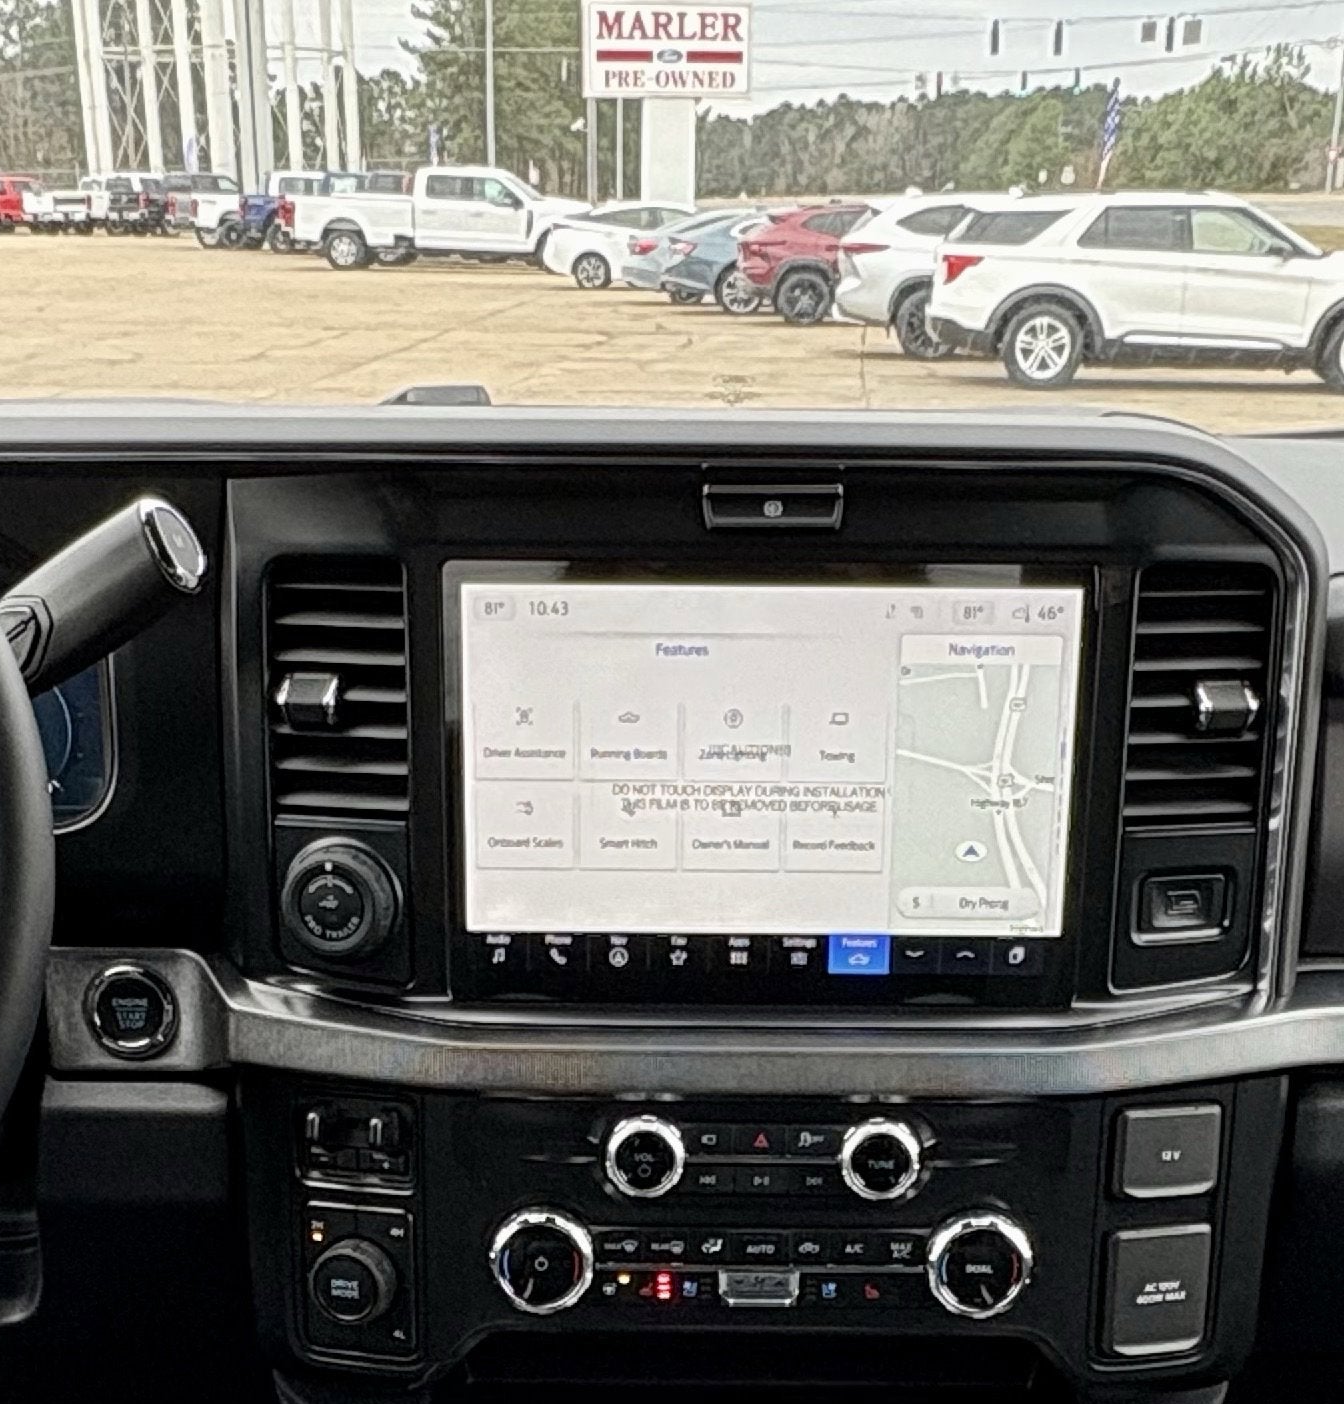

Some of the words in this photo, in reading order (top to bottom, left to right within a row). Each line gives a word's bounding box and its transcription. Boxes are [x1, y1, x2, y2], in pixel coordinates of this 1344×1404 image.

[596, 11, 744, 41] MARLER
[604, 70, 736, 88] PRE-OWNED
[655, 643, 710, 656] Features
[948, 643, 1016, 659] Navigation
[819, 750, 855, 763] Towing
[612, 783, 630, 796] DO
[633, 784, 655, 796] NOT
[660, 784, 701, 796] TOUCH
[703, 785, 754, 797] DISPLAY
[756, 785, 800, 797] DURING
[649, 799, 677, 810] FILM
[692, 800, 709, 811] TO
[746, 1244, 775, 1254] AUTO
